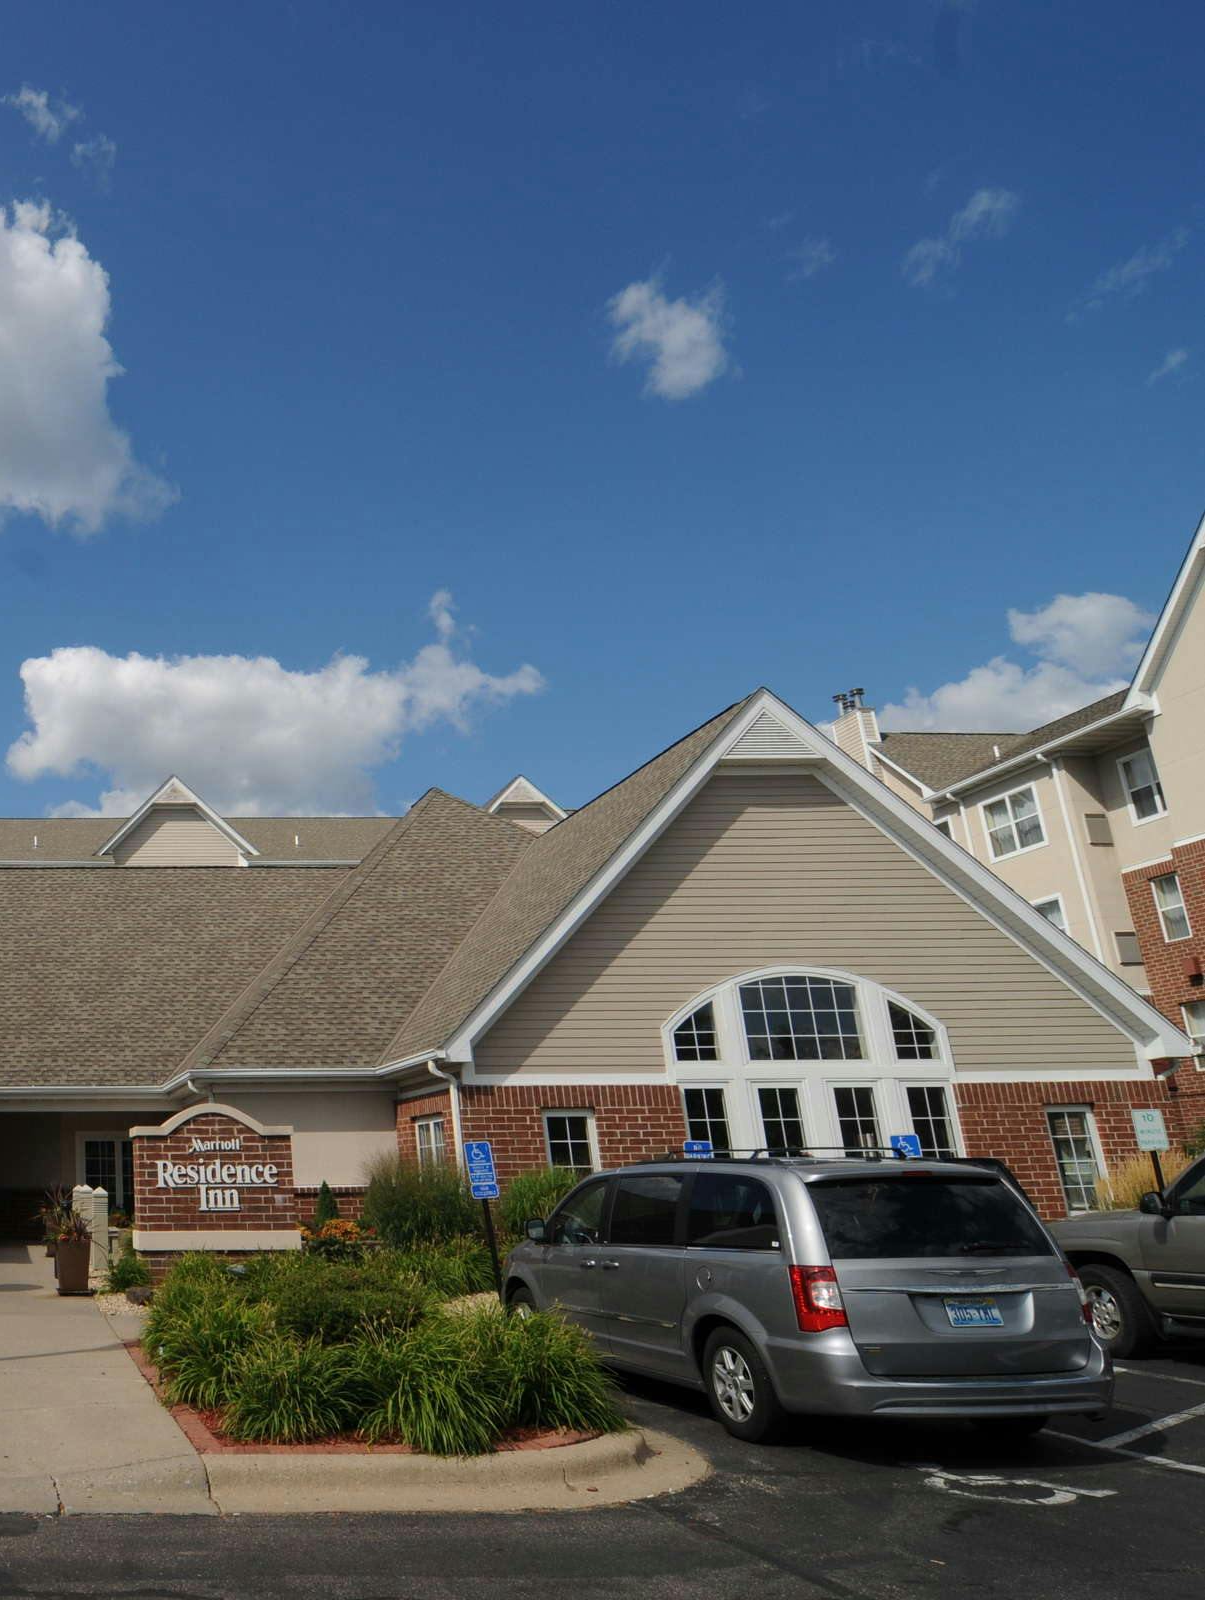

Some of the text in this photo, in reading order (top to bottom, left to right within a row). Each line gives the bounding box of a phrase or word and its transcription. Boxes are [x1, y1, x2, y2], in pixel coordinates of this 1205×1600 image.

[188, 1136, 241, 1152] Marriott
[156, 1158, 278, 1187] Residence
[198, 1184, 240, 1211] Inn
